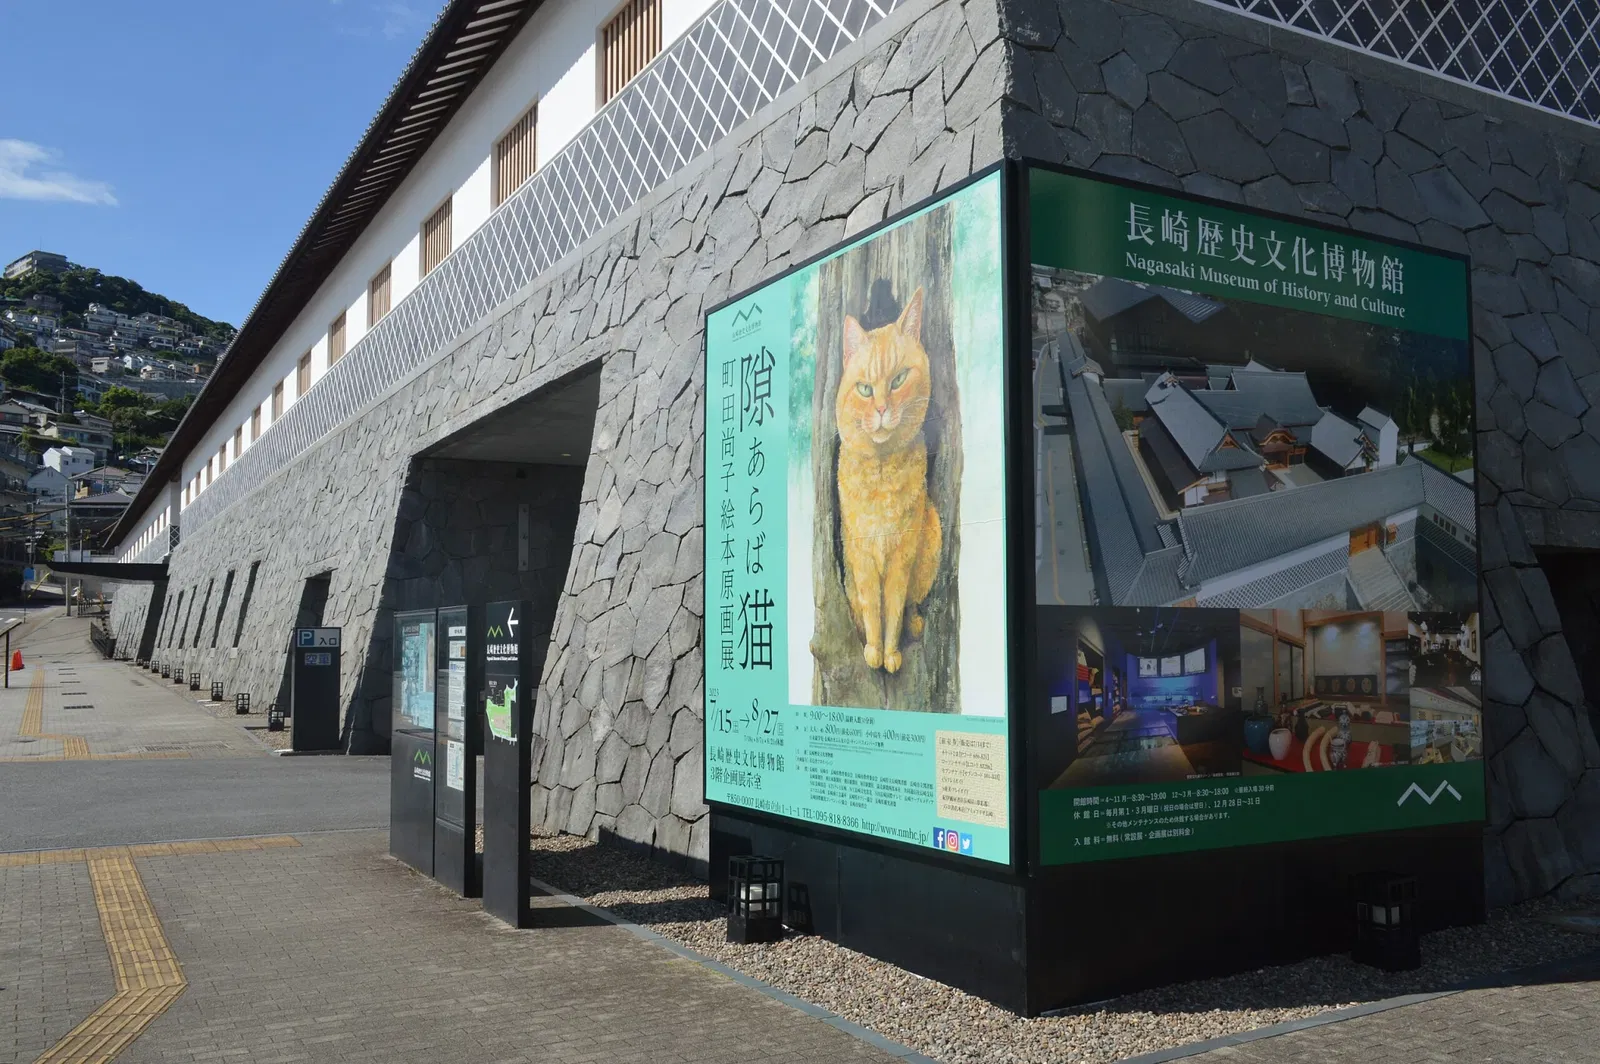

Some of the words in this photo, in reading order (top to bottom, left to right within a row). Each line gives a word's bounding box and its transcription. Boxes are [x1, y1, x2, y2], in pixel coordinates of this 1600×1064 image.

[1125, 201, 1404, 295] 長崎歴史文化博物館
[1125, 251, 1196, 280] Nagasaki
[1199, 265, 1260, 290] Museum
[1263, 279, 1278, 294] of
[1282, 281, 1331, 308] History
[1334, 292, 1358, 309] and
[1361, 296, 1406, 318] Culture
[738, 345, 776, 671] 隙あらば猫
[301, 631, 312, 645] P
[319, 636, 338, 646] 入口
[710, 745, 785, 773] 長崎歴史文化博物館
[710, 766, 762, 790] 3階企画展示室
[861, 818, 930, 845] http://www.nmhc.jp/
